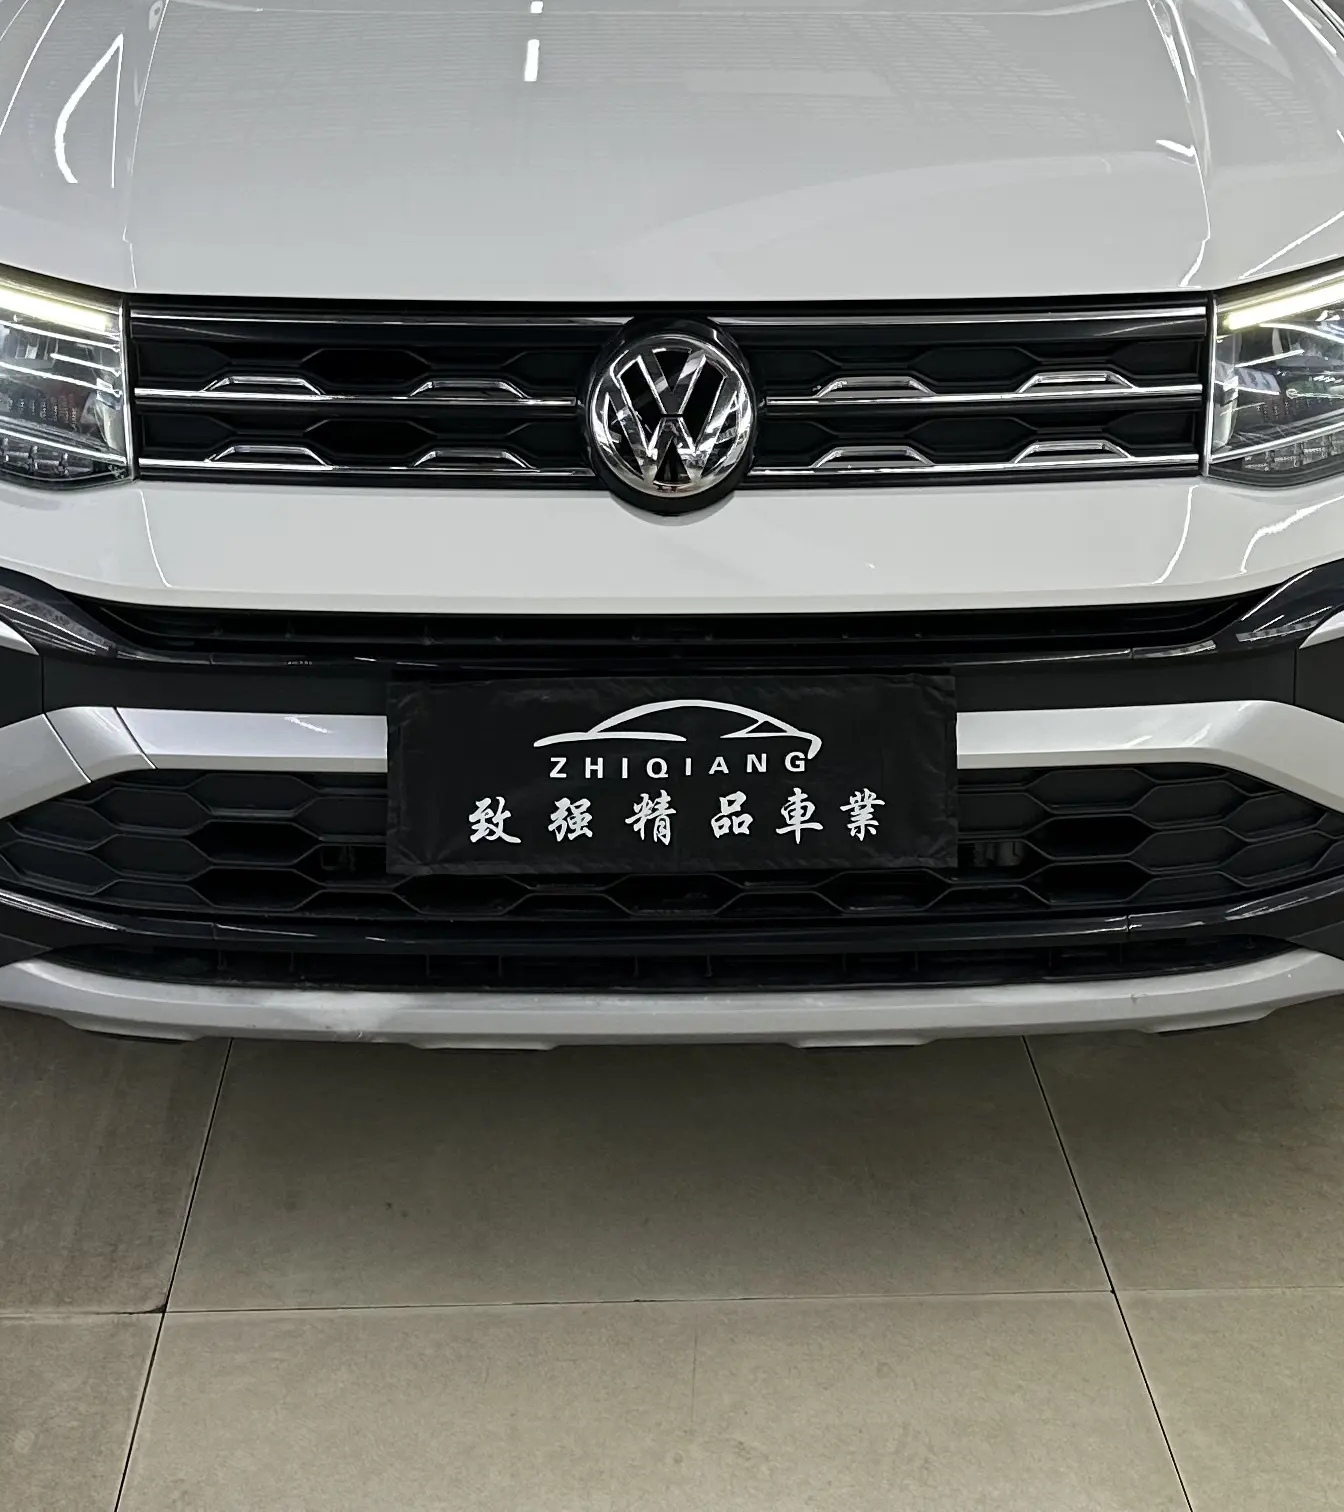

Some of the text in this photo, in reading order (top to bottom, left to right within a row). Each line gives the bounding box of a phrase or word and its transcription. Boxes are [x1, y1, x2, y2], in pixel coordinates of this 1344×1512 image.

[548, 750, 808, 780] ZHIQIANG
[468, 787, 886, 846] 致强精品車業
